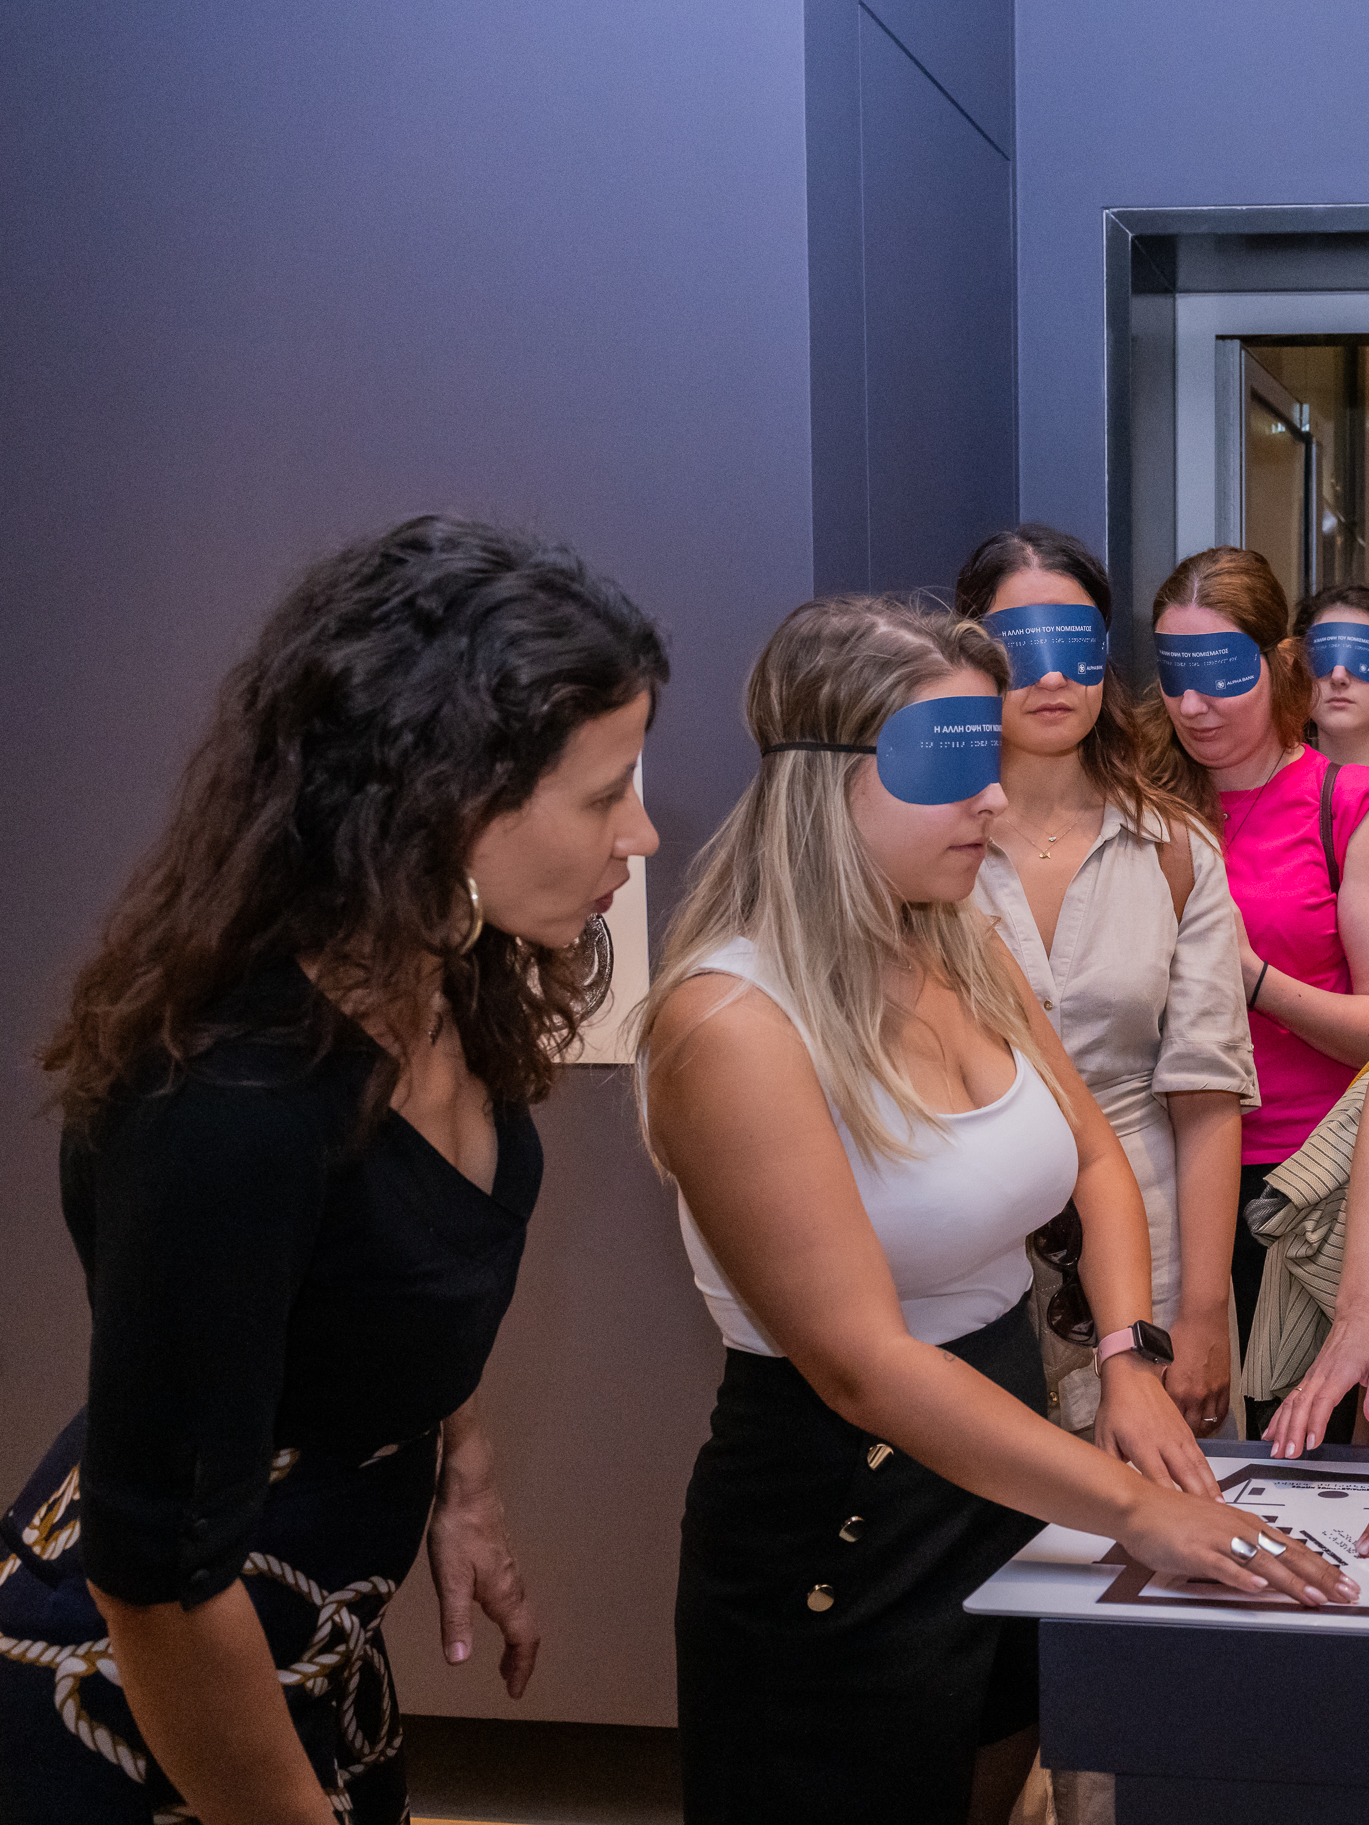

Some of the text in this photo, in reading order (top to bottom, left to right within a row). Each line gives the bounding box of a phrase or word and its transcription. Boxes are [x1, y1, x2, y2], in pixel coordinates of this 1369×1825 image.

[1007, 628, 1024, 636] ΑΛΛΗ
[933, 725, 941, 733] Η
[942, 725, 964, 733] ΑΛΛΗ
[965, 724, 982, 733] ΟΨΗ
